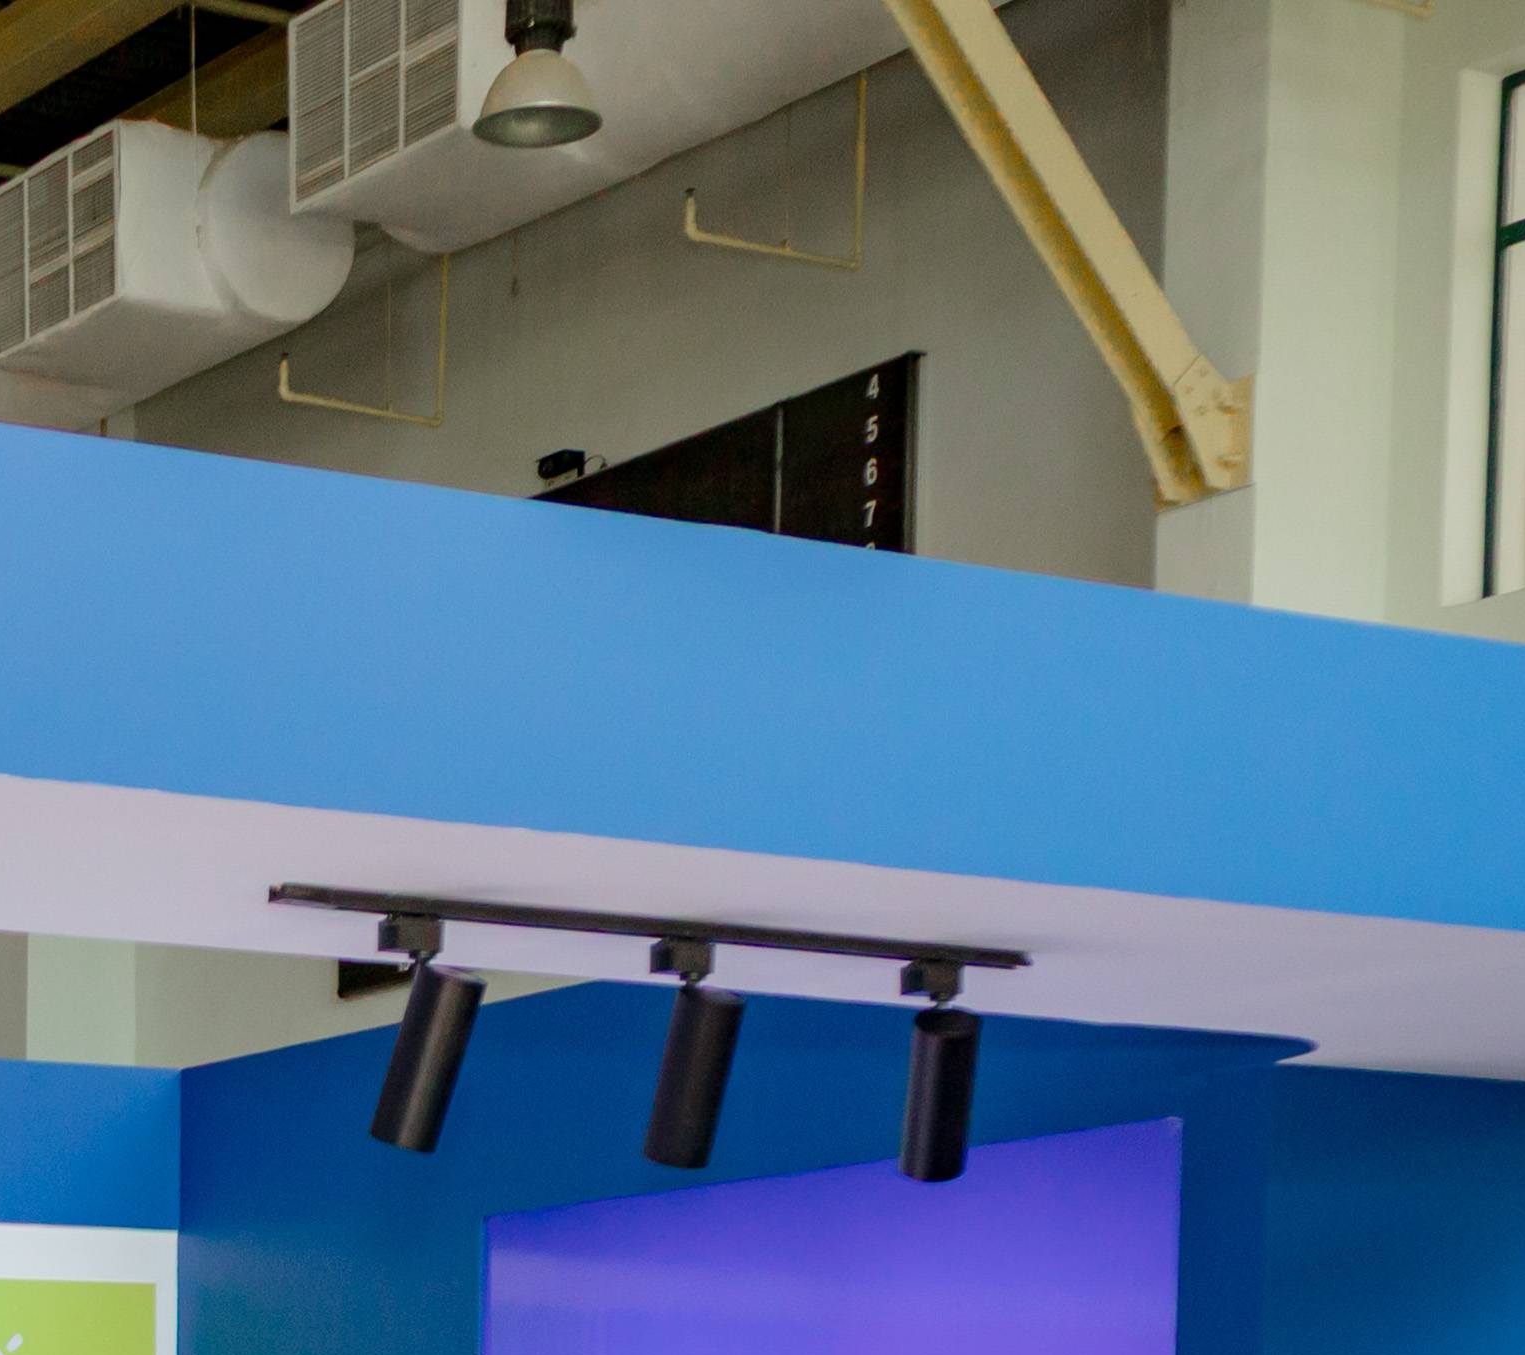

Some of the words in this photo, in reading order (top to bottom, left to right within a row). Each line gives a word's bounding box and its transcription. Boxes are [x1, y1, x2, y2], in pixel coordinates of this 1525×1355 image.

[866, 373, 880, 399] 4
[865, 415, 879, 443] 5
[865, 457, 878, 486] 6
[864, 499, 877, 528] 7
